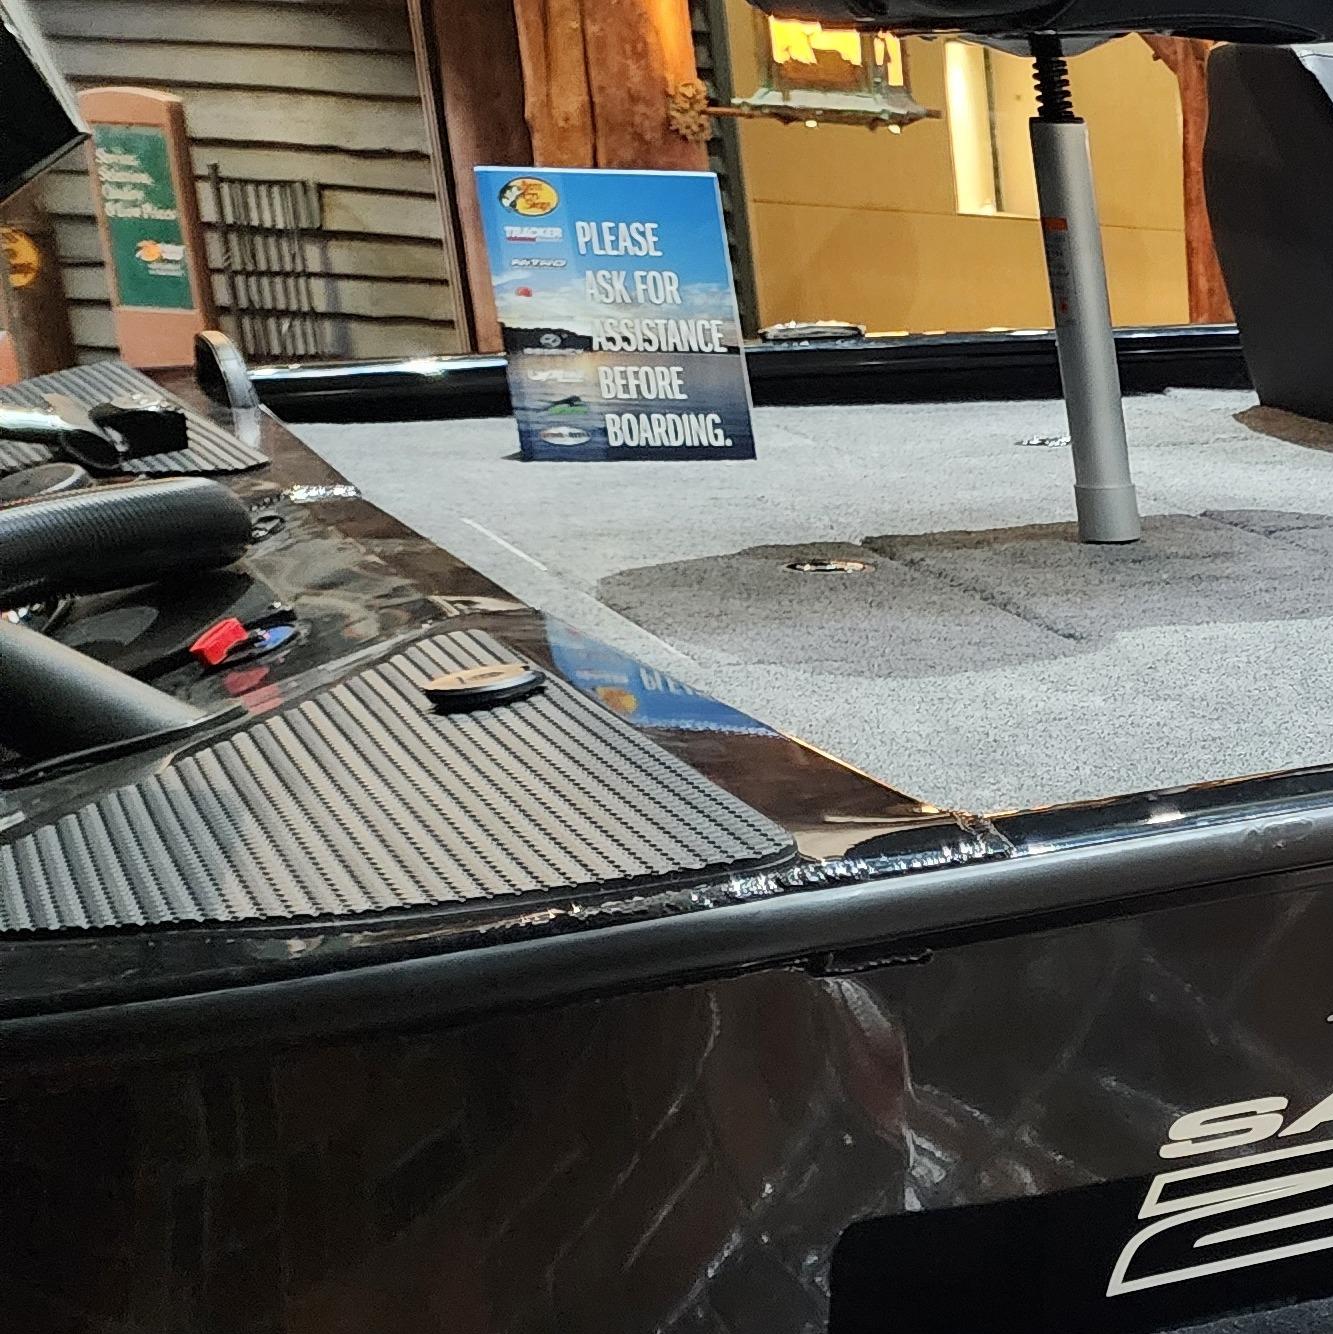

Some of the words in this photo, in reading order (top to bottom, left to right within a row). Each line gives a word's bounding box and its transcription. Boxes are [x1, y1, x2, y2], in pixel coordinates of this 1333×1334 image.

[504, 226, 562, 238] TRACKER
[575, 221, 663, 257] PLEASE
[585, 269, 632, 304] ASK
[634, 270, 682, 305] FOR
[591, 318, 729, 353] ASSISTANCE
[598, 366, 689, 400] BEFORE
[605, 413, 733, 447] BOARDING.
